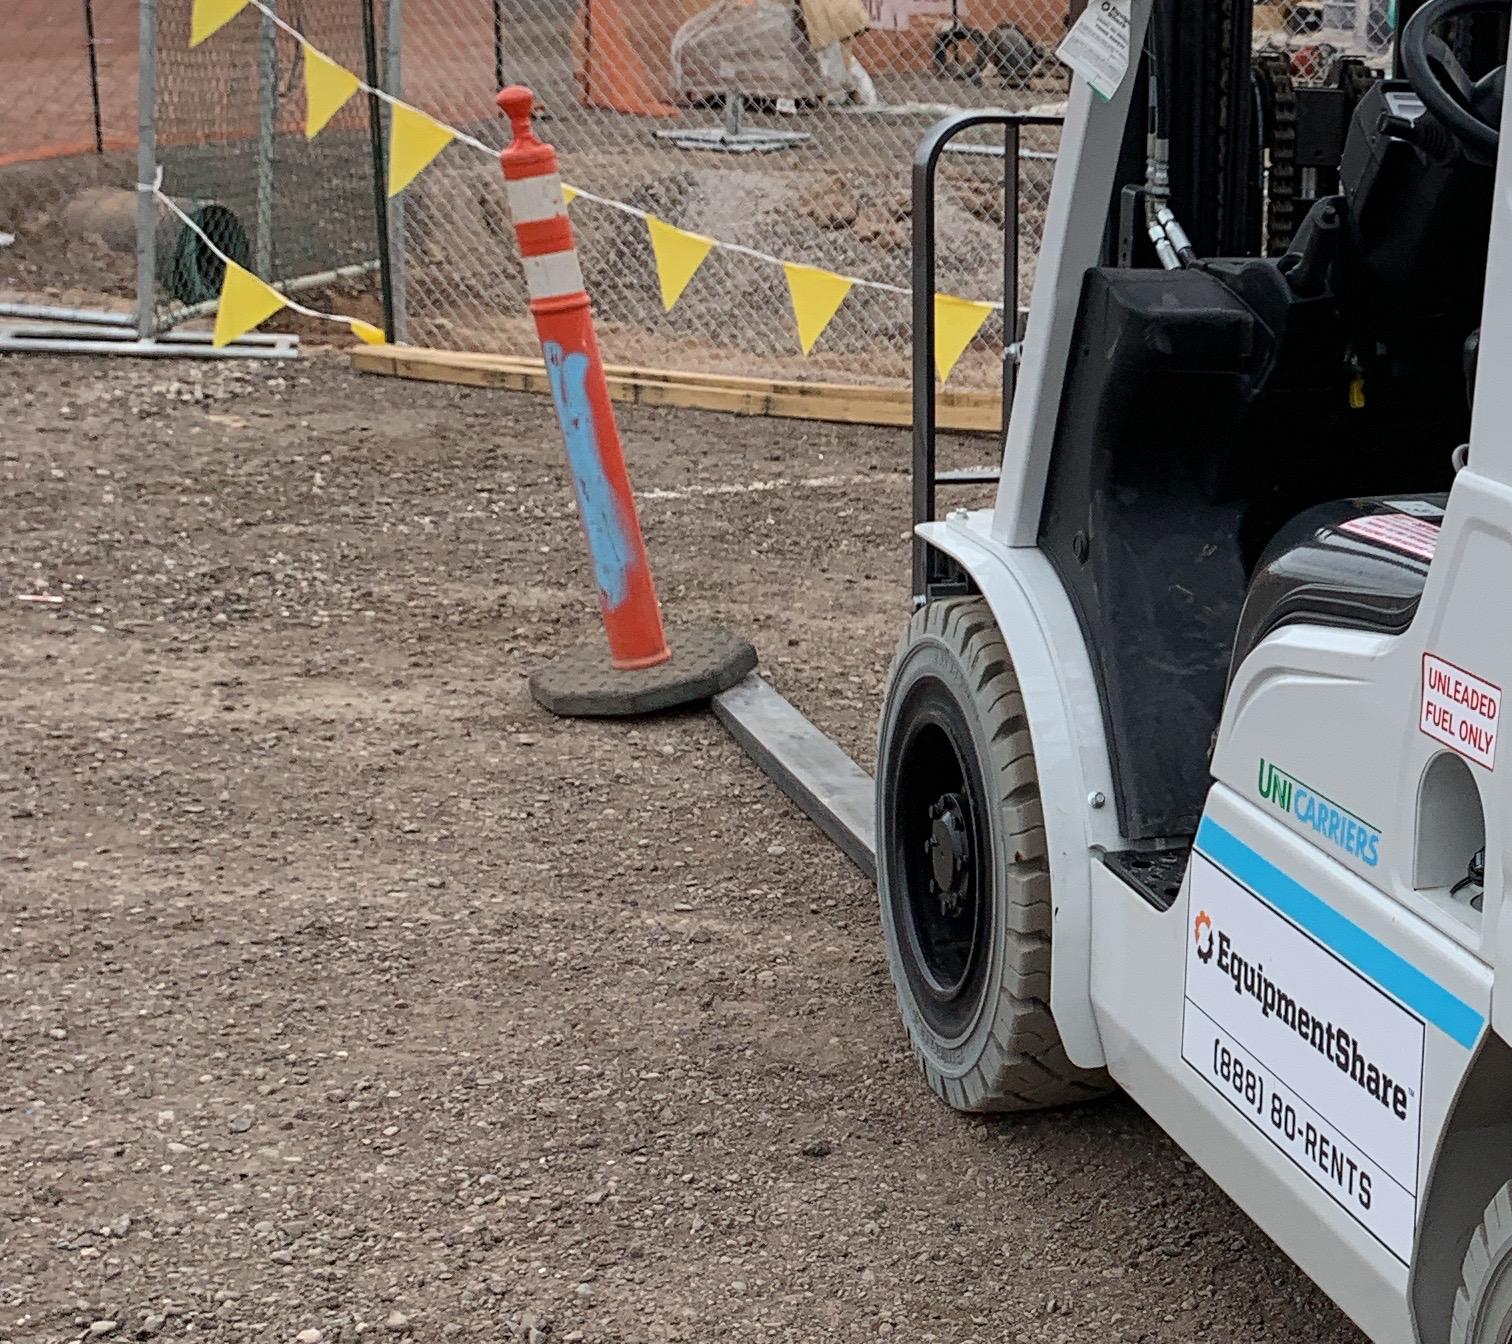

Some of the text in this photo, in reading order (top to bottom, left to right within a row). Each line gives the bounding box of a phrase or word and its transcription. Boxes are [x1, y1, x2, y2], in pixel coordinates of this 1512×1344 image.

[1428, 666, 1496, 720] UNLEADED
[1425, 701, 1494, 756] FUEL ONLY
[1213, 1038, 1372, 1211] (888) 80-RENTS
